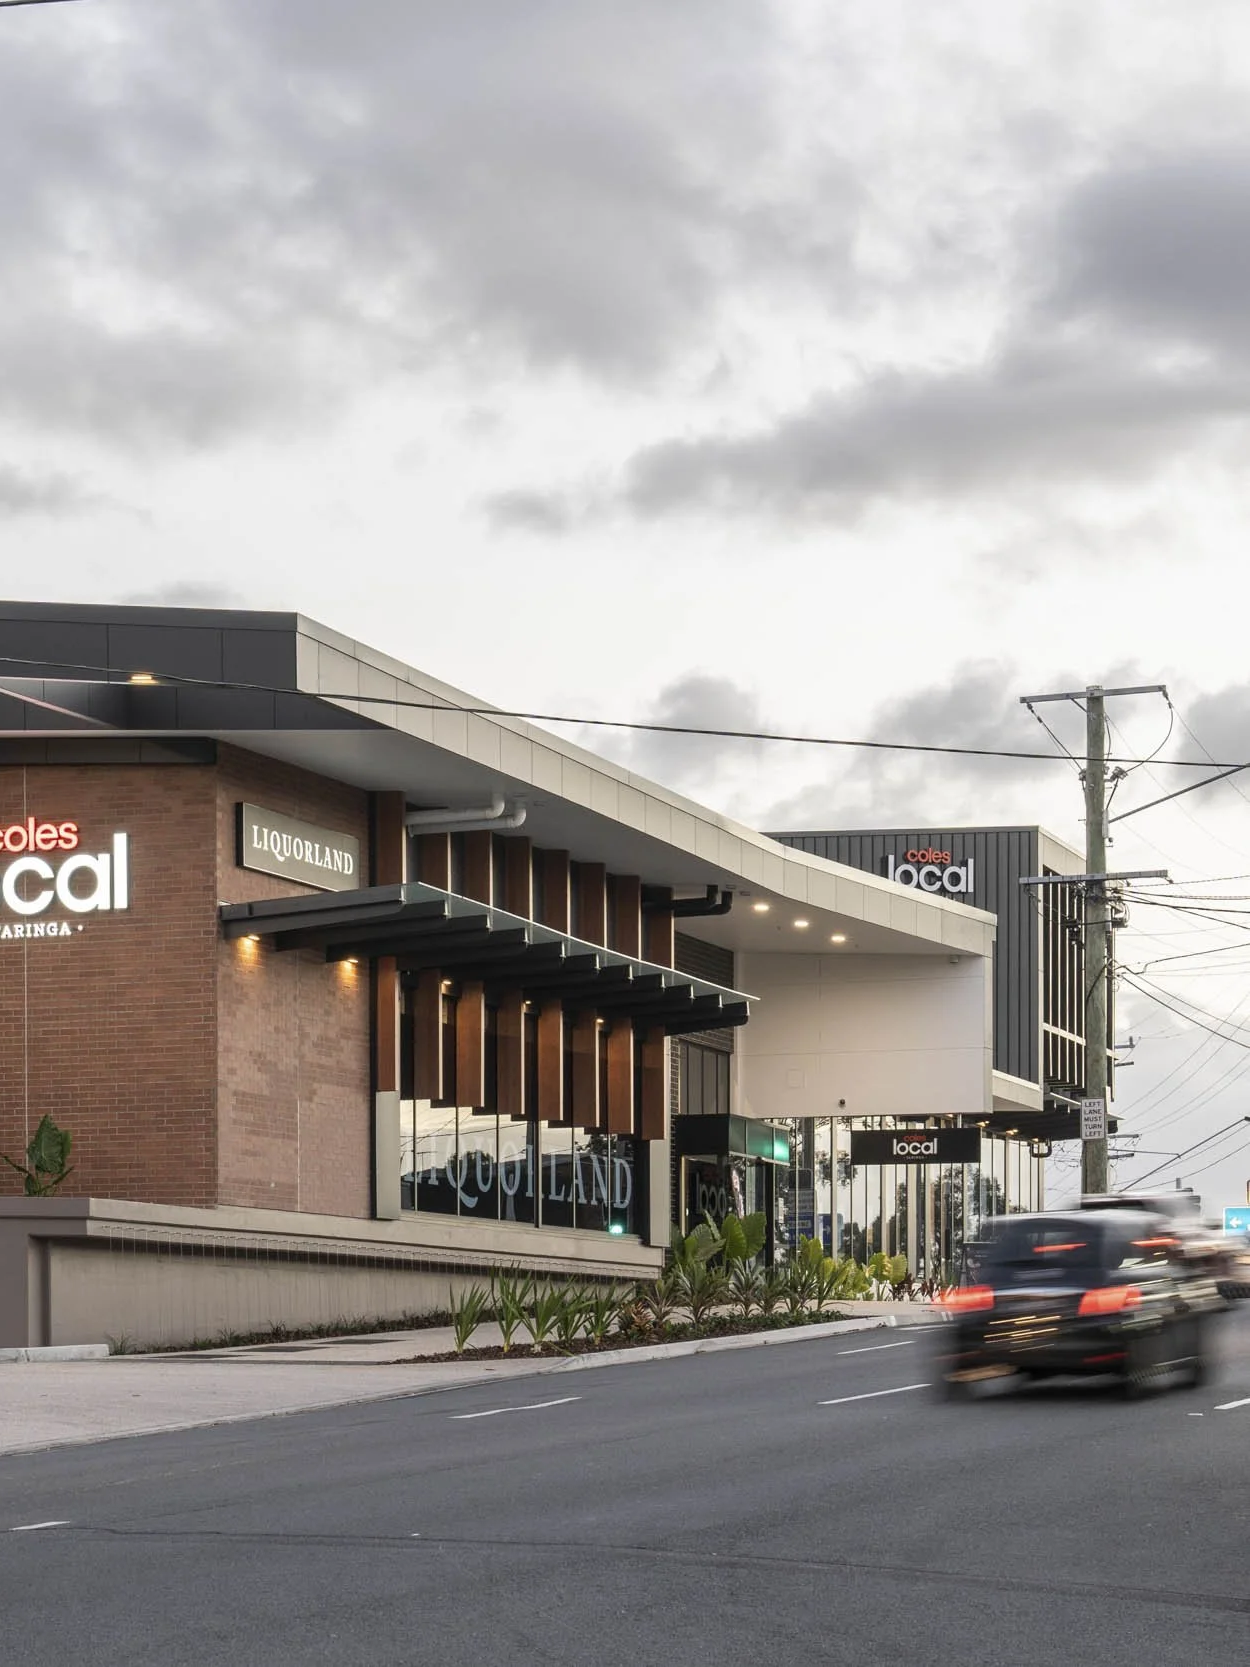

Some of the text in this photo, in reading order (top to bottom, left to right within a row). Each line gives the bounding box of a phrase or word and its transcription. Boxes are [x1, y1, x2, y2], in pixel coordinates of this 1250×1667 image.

[252, 825, 354, 875] LIQUORLAND
[907, 847, 951, 864] coles
[888, 854, 974, 892] local
[893, 1138, 938, 1155] local
